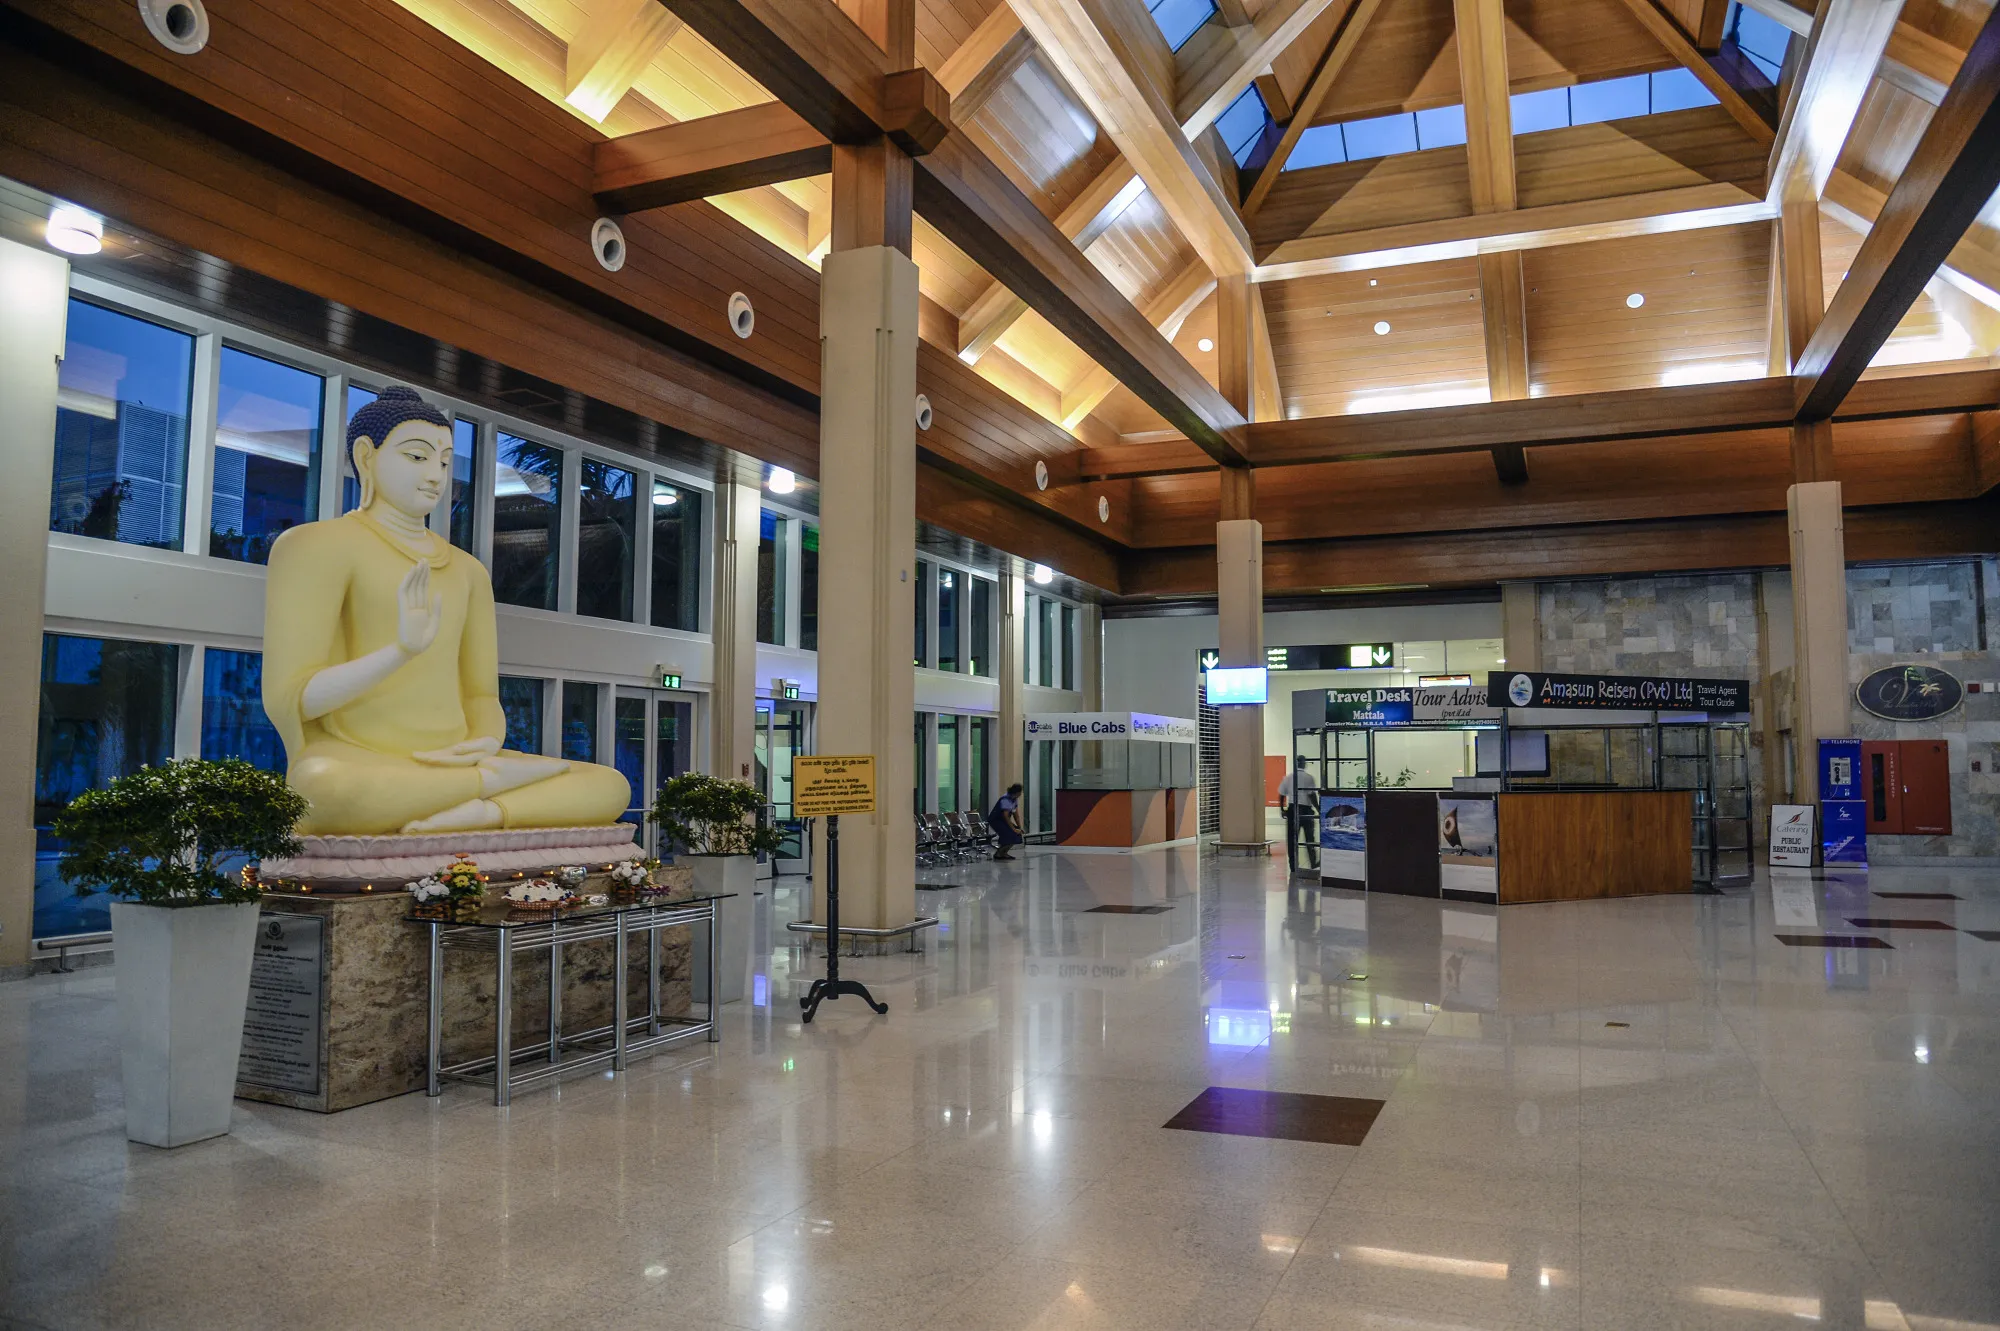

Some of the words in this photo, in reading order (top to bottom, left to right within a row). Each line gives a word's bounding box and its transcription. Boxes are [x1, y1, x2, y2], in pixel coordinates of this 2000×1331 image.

[1327, 690, 1373, 703] Travel
[1376, 689, 1411, 702] Desk
[1540, 678, 1594, 698] Amasun
[1598, 680, 1636, 699] Reisen
[1640, 681, 1671, 700] (Pvt)
[1675, 681, 1693, 702] Ltd
[1697, 685, 1716, 695] Travel
[1718, 686, 1738, 697] Agent
[1414, 689, 1446, 706] Tour
[1700, 698, 1714, 707] Tour
[1716, 698, 1735, 707] Guide
[1353, 710, 1385, 720] Mattala
[1058, 722, 1088, 734] Blue
[1091, 721, 1126, 734] Cabs
[1776, 825, 1809, 836] Catering
[1773, 846, 1810, 854] RESTAURANT
